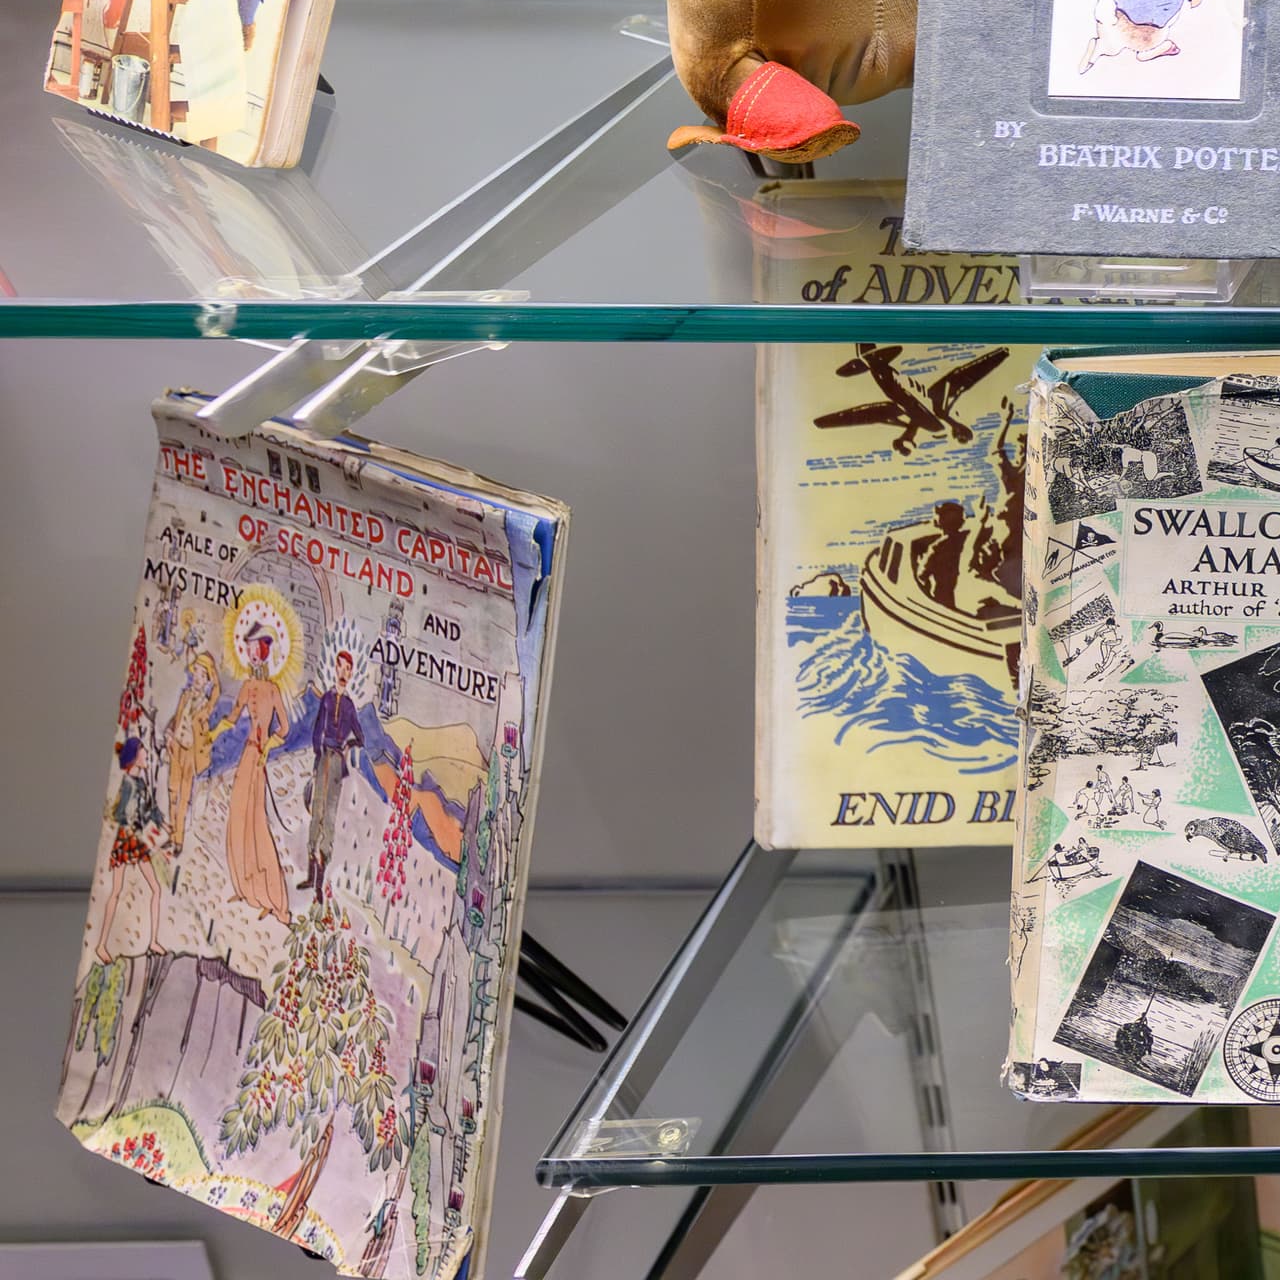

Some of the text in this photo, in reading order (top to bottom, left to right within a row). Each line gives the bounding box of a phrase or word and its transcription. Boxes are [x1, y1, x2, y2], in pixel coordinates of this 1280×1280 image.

[994, 121, 1026, 137] BY
[1038, 144, 1162, 168] BEATRIX
[161, 447, 514, 590] THE ENCHANTED CAPITAL
[175, 530, 213, 556] TALE
[218, 544, 239, 563] OF
[238, 514, 413, 597] OF SCOTLAND
[144, 558, 244, 610] MYSTERY
[1162, 579, 1267, 597] ARTHUR
[1168, 600, 1233, 616] author
[1243, 600, 1266, 617] of
[423, 613, 460, 640] AND
[370, 638, 499, 703] ADVENTURE
[830, 791, 955, 826] ENID
